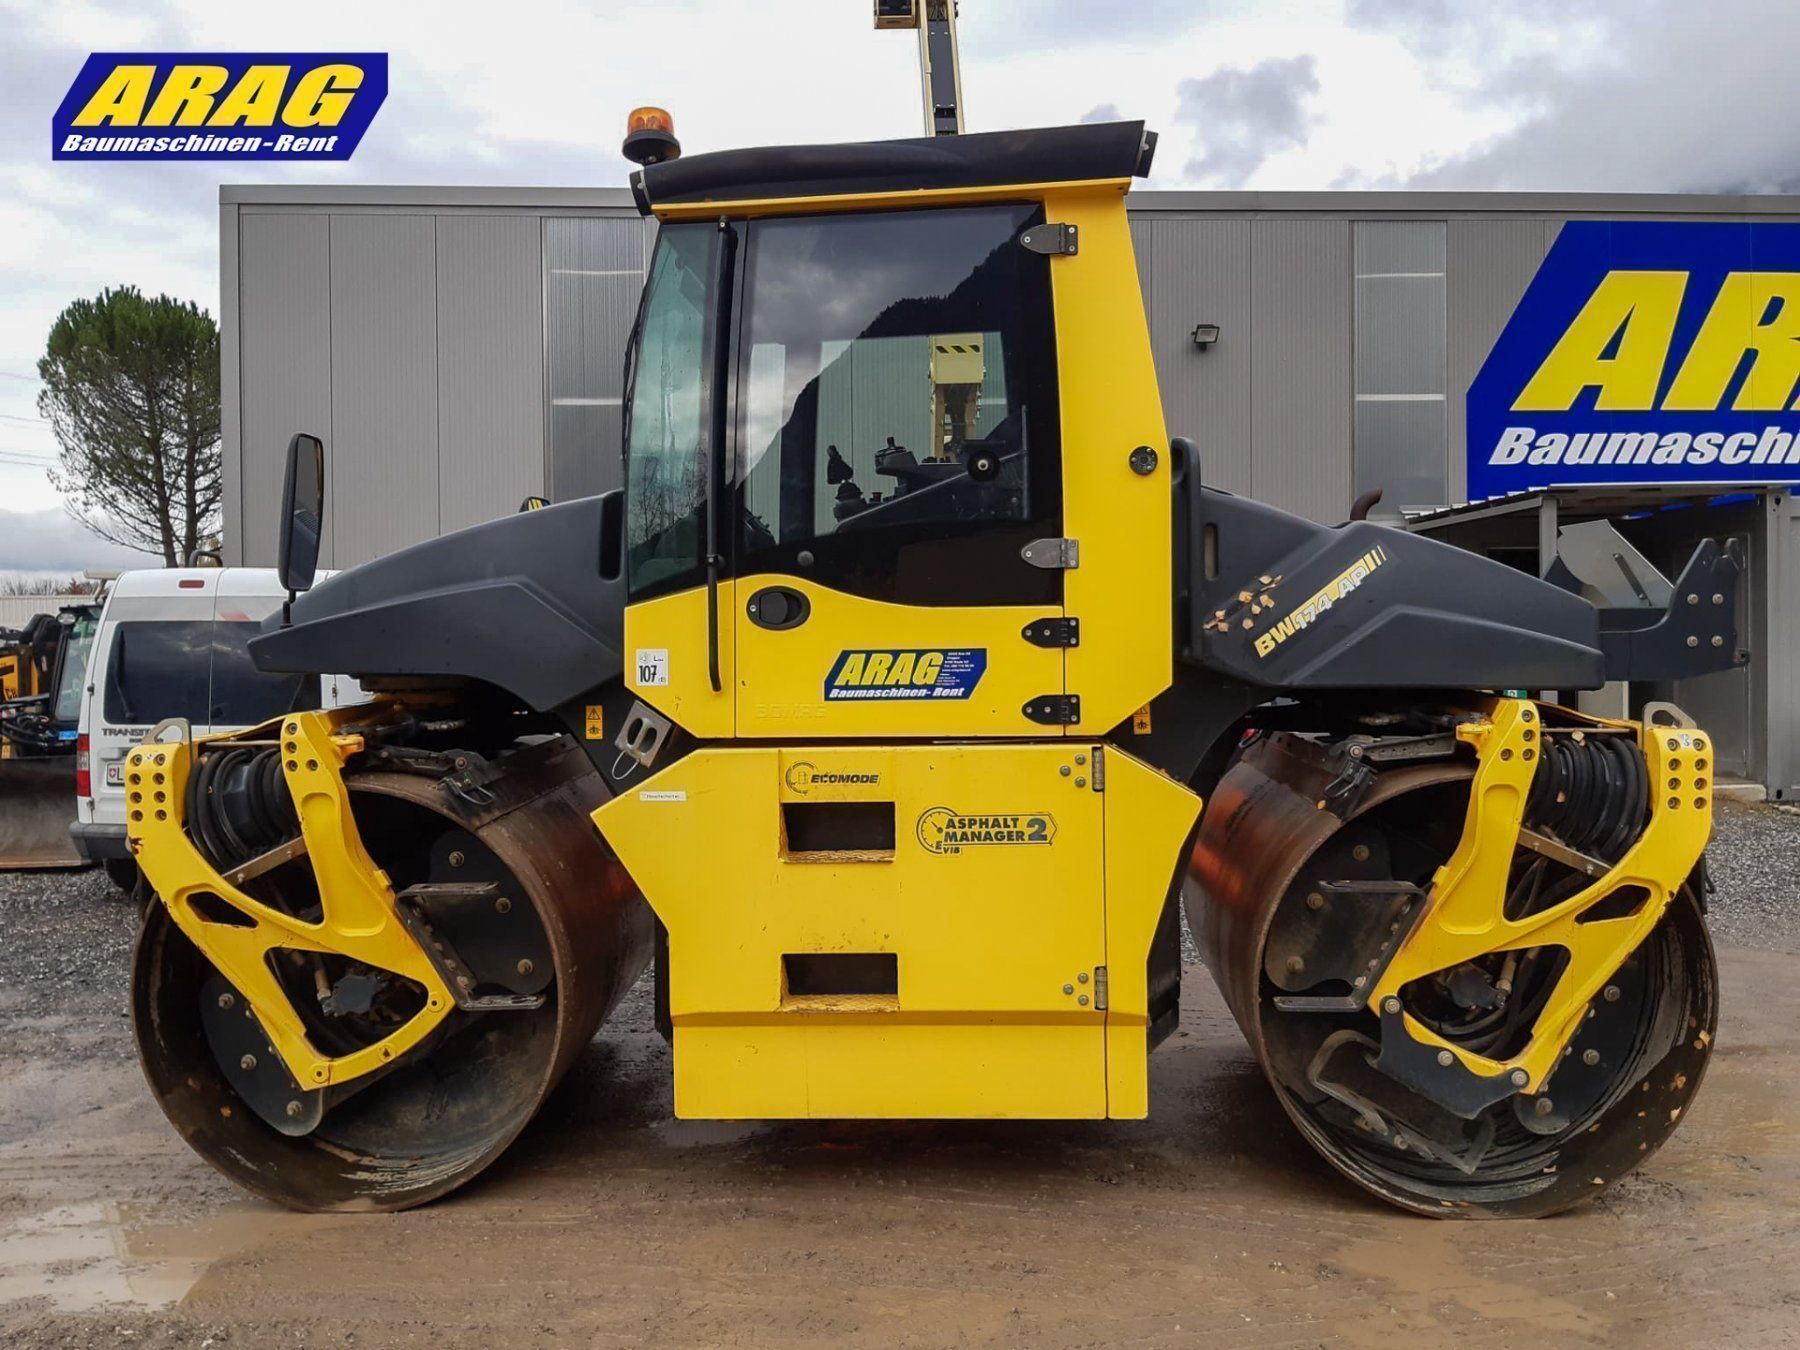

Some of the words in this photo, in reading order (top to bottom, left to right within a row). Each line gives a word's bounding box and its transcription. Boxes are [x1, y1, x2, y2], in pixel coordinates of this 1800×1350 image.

[1509, 269, 1800, 411] AR
[639, 664, 657, 683] 107
[833, 651, 944, 686] ARAG
[102, 728, 152, 737] TRANSIT
[811, 774, 879, 784] ECOMODE
[943, 830, 1026, 843] MANAGER
[1026, 817, 1048, 842] 2
[945, 817, 1020, 830] ASPHALT
